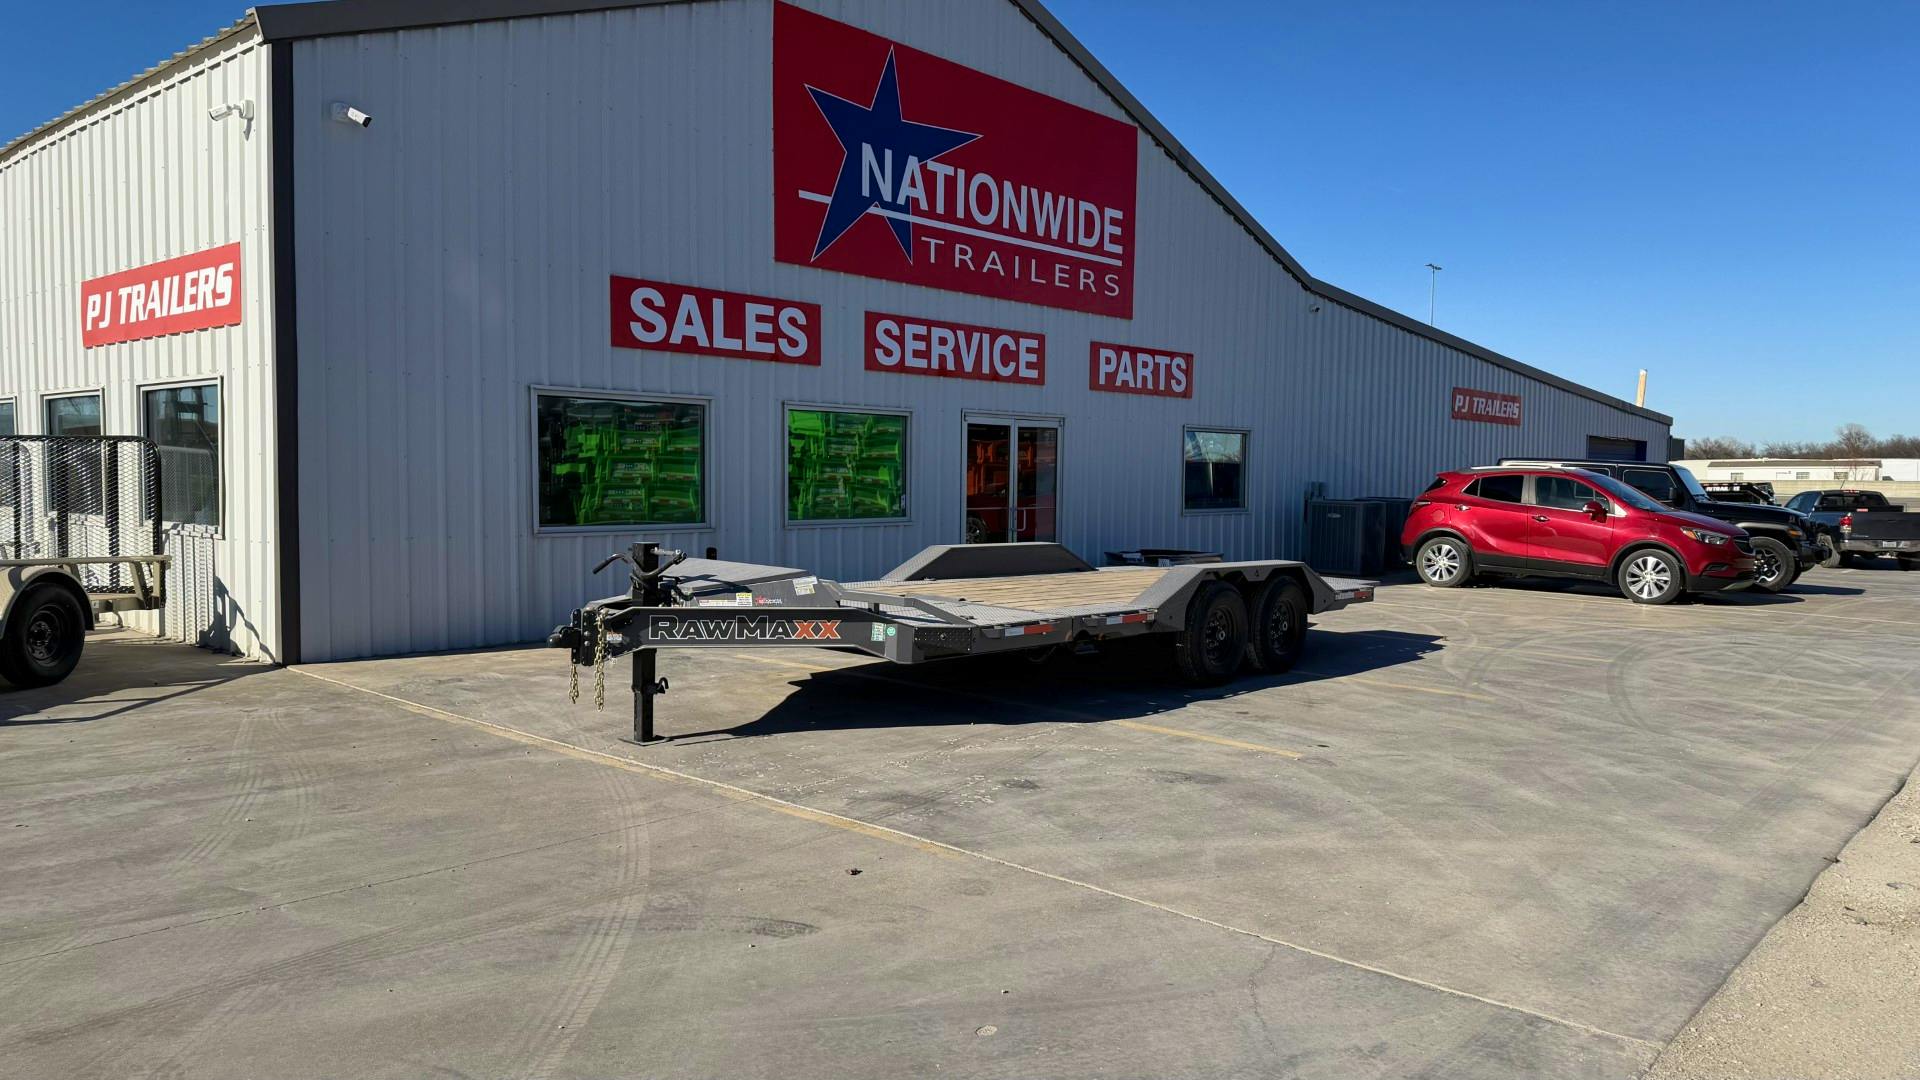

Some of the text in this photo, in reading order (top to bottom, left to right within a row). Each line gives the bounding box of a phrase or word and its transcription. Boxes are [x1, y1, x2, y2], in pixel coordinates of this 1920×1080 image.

[861, 142, 1123, 254] NATIONWIDE
[86, 262, 233, 331] PJ TRAILERS
[921, 236, 1120, 297] TRAILERS
[630, 287, 808, 357] SALES
[875, 319, 1039, 378] SERVICE
[1099, 348, 1187, 392] PARTS
[1455, 394, 1520, 418] PJ TRAILERS
